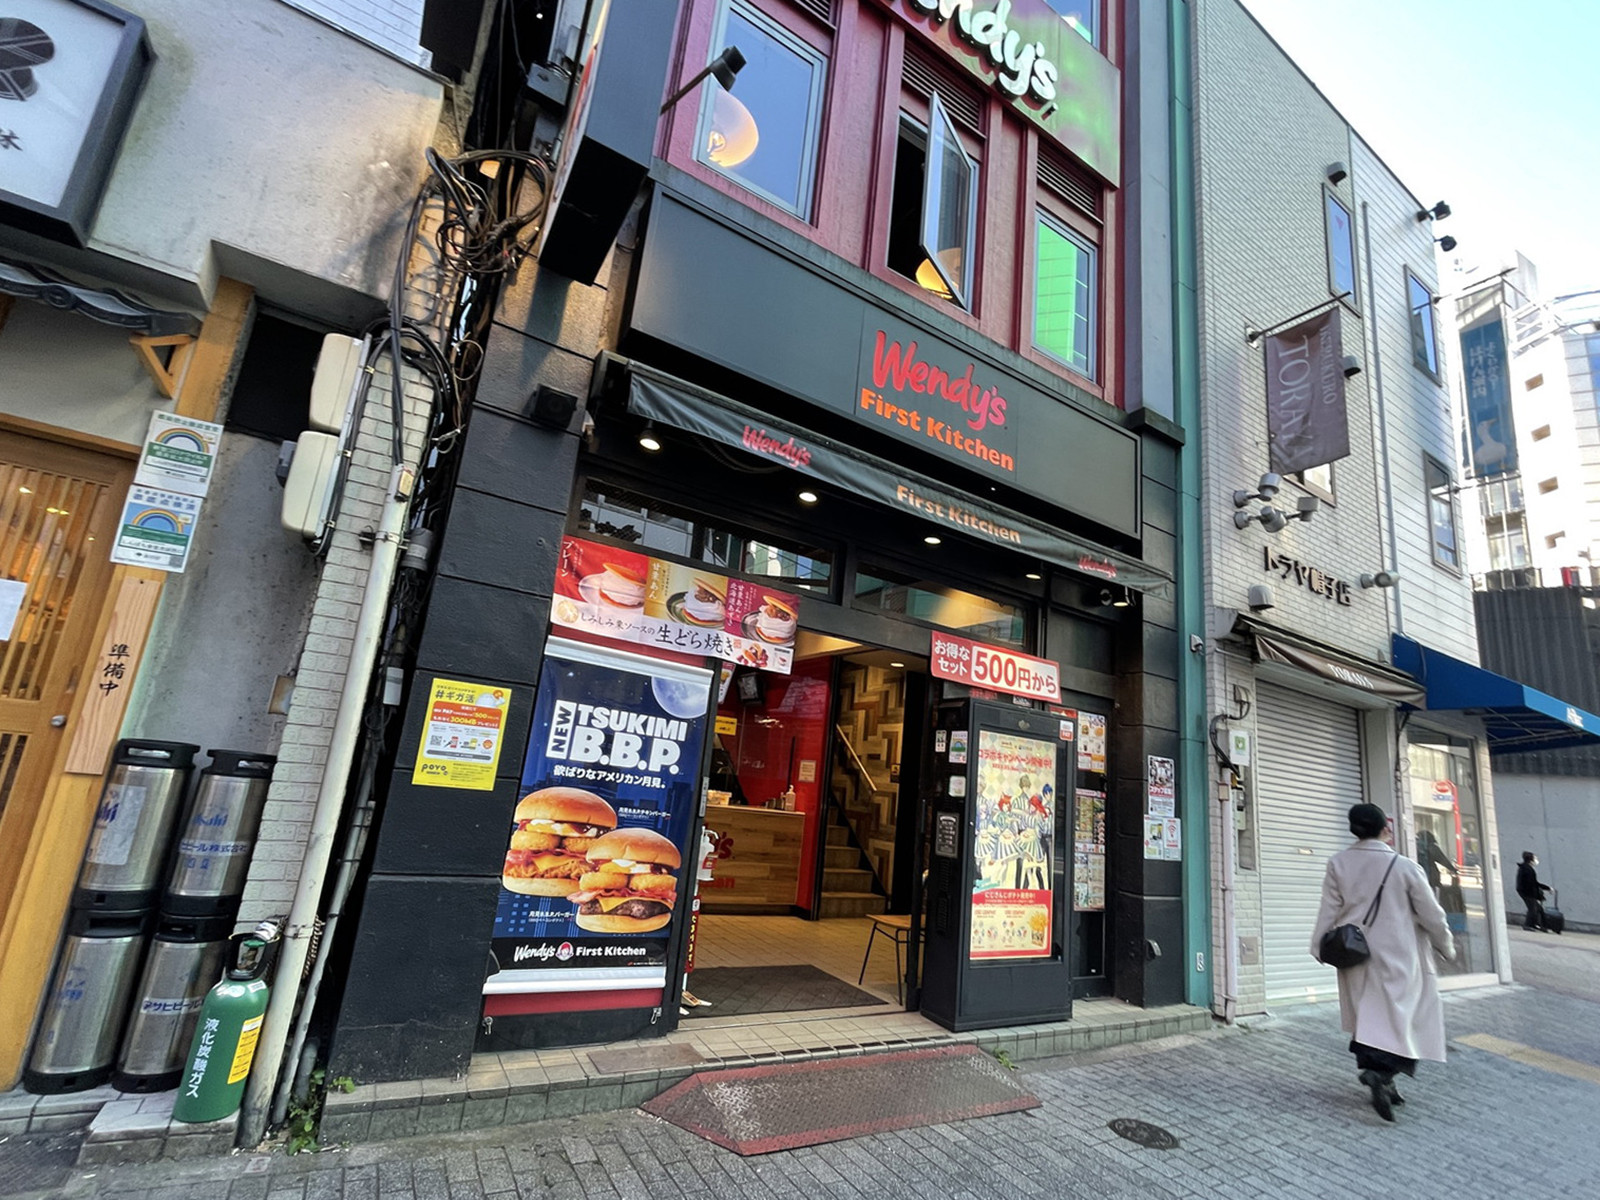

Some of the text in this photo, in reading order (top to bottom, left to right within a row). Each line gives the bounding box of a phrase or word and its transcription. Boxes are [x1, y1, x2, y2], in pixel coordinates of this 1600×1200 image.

[915, 0, 1058, 100] ndy's
[871, 329, 1007, 431] Wendy's
[742, 425, 812, 468] Wendy's
[860, 388, 1014, 471] First Kitchen
[897, 485, 1021, 544] First Kitchen
[1264, 546, 1352, 606] トラヤ帽子店
[99, 643, 130, 697] 準備中
[934, 640, 971, 662] お得な
[937, 656, 969, 677] セット
[973, 651, 1057, 695] 500円から
[551, 704, 572, 753] NEW
[577, 703, 688, 742] TSUKIMI
[421, 763, 447, 773] povo
[568, 725, 681, 775] B.B.P.
[553, 764, 667, 789] 欲ばりなアメリカン月見。
[513, 942, 646, 962] Wendy's First Kitchen
[186, 1017, 219, 1099] 液化炭酸ガス
